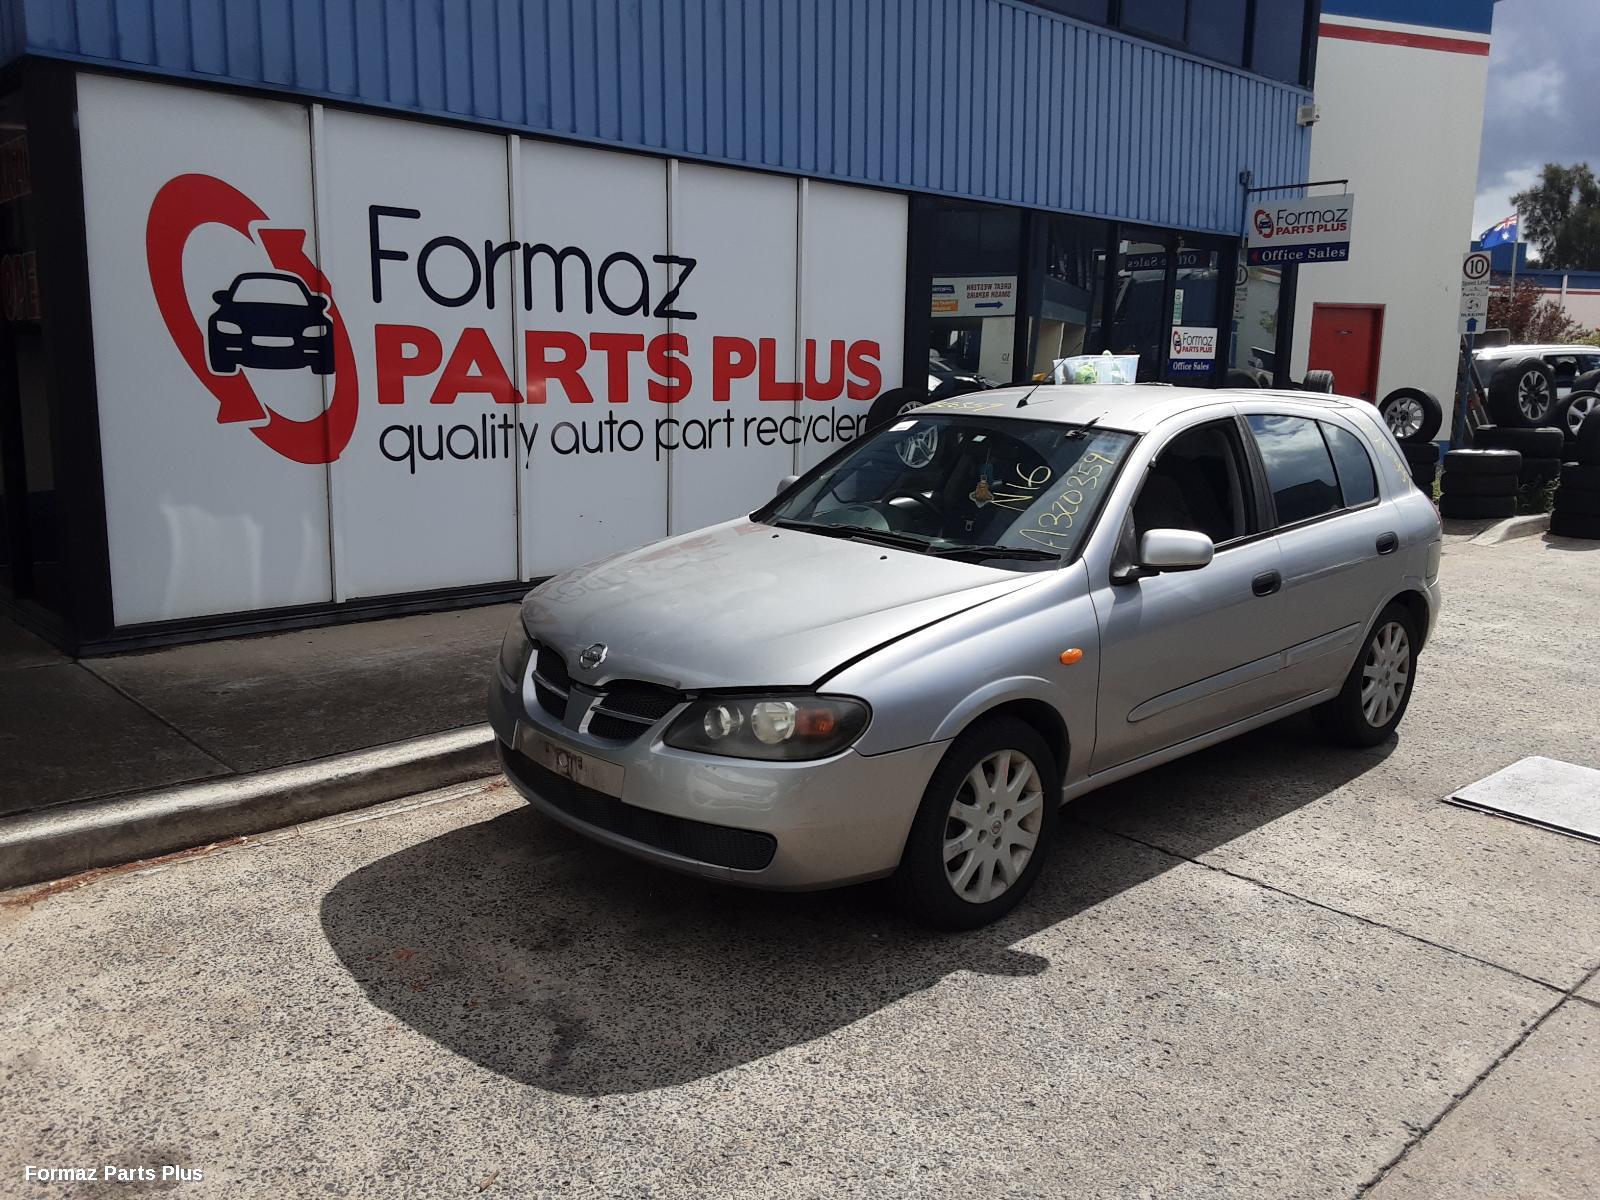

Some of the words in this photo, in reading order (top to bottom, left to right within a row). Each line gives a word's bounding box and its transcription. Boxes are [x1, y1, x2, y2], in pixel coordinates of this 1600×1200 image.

[1276, 208, 1349, 226] Formaz
[1276, 224, 1314, 236] PARTS
[1317, 222, 1348, 233] PLUS
[1262, 250, 1303, 261] Office
[1307, 246, 1346, 259] Sales
[369, 204, 698, 321] Formaz
[1470, 259, 1484, 274] 10
[1182, 332, 1213, 347] Formaz
[374, 323, 692, 405] PARTS
[712, 336, 883, 402] PLUS
[1172, 361, 1192, 371] Office
[1192, 361, 1210, 371] Sales
[379, 412, 539, 475] quality
[550, 409, 644, 455] auto
[655, 409, 735, 461] part
